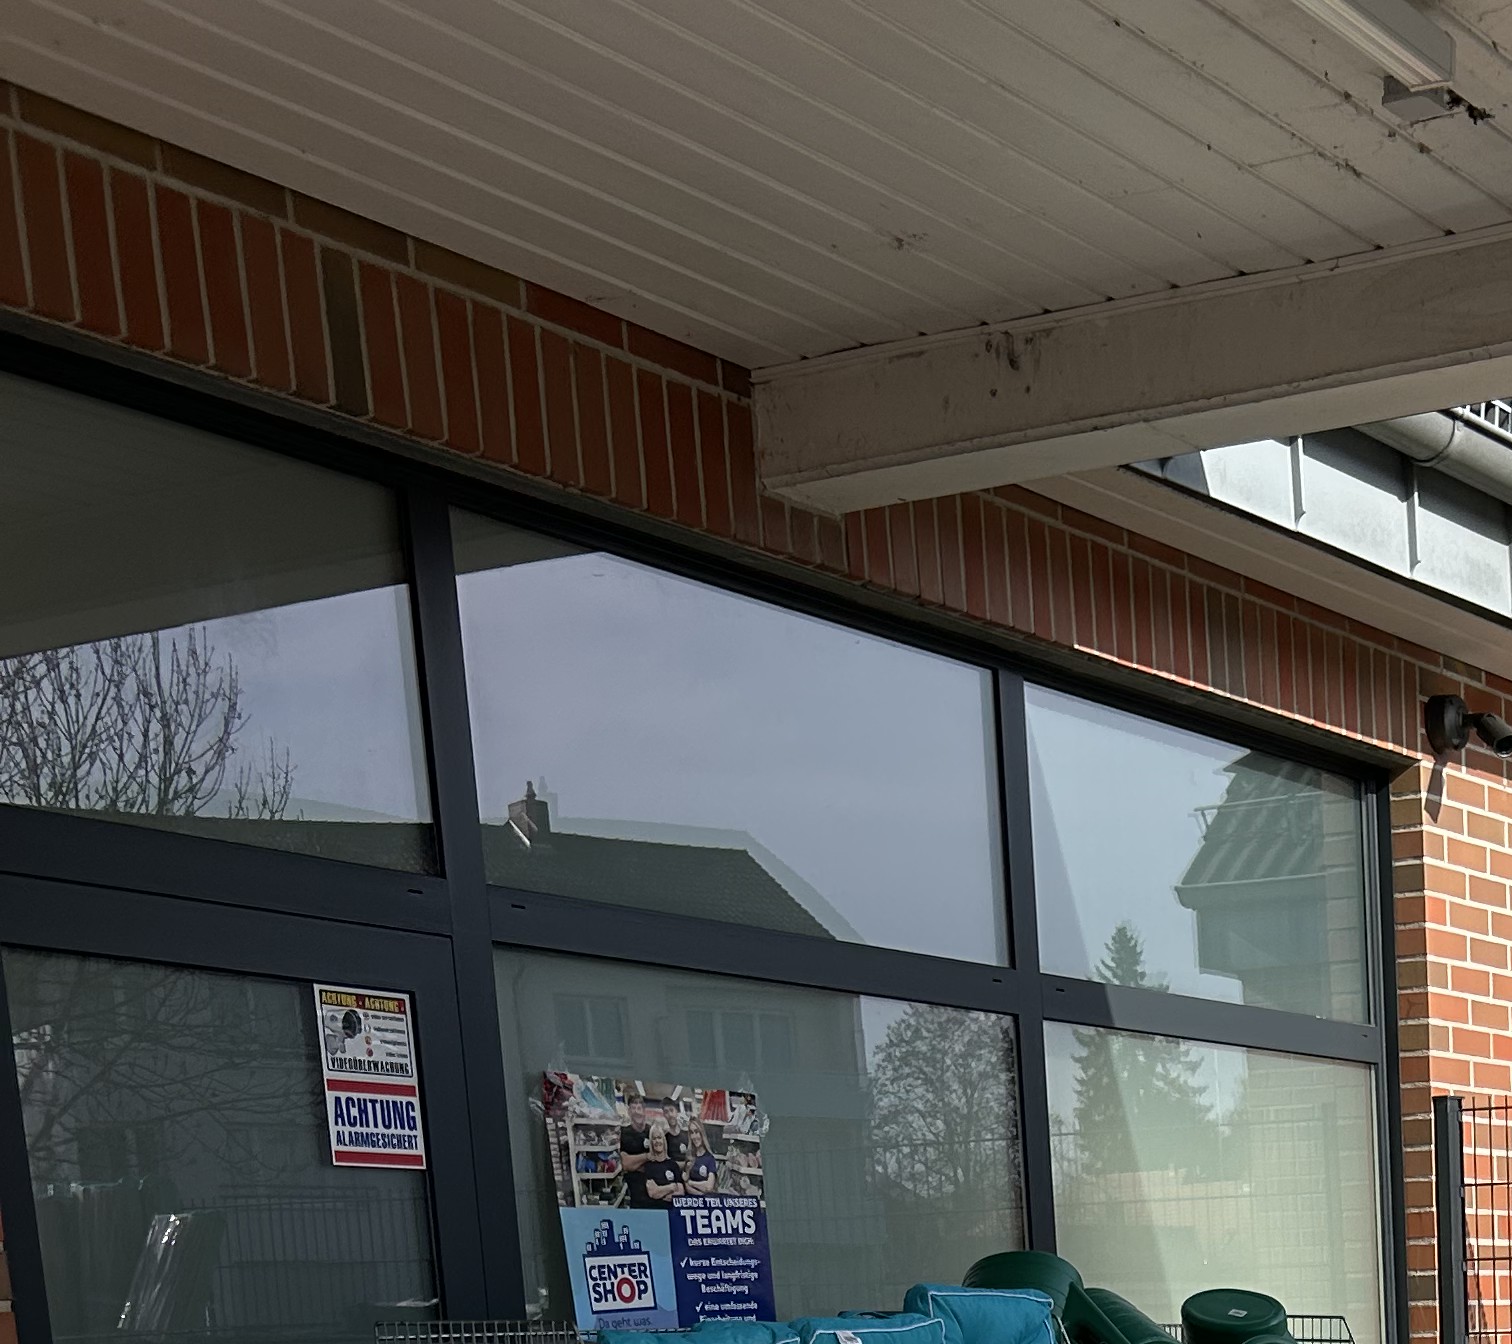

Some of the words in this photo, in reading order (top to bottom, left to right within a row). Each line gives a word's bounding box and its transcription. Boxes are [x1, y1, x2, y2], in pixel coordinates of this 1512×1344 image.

[330, 1057, 409, 1075] VIDEOÜBERWACHUNG
[334, 1096, 417, 1131] ACHTUNG
[336, 1130, 418, 1150] ALARMGESICHERT
[673, 1197, 704, 1208] WERDE
[705, 1197, 723, 1208] TEIL
[724, 1197, 758, 1208] UNSERES
[680, 1209, 756, 1234] TEAMS
[588, 1262, 649, 1282] CENTER
[592, 1277, 648, 1304] SHOP
[701, 1283, 749, 1294] Beschäftigung
[598, 1317, 610, 1329] Da
[611, 1317, 632, 1332] geht
